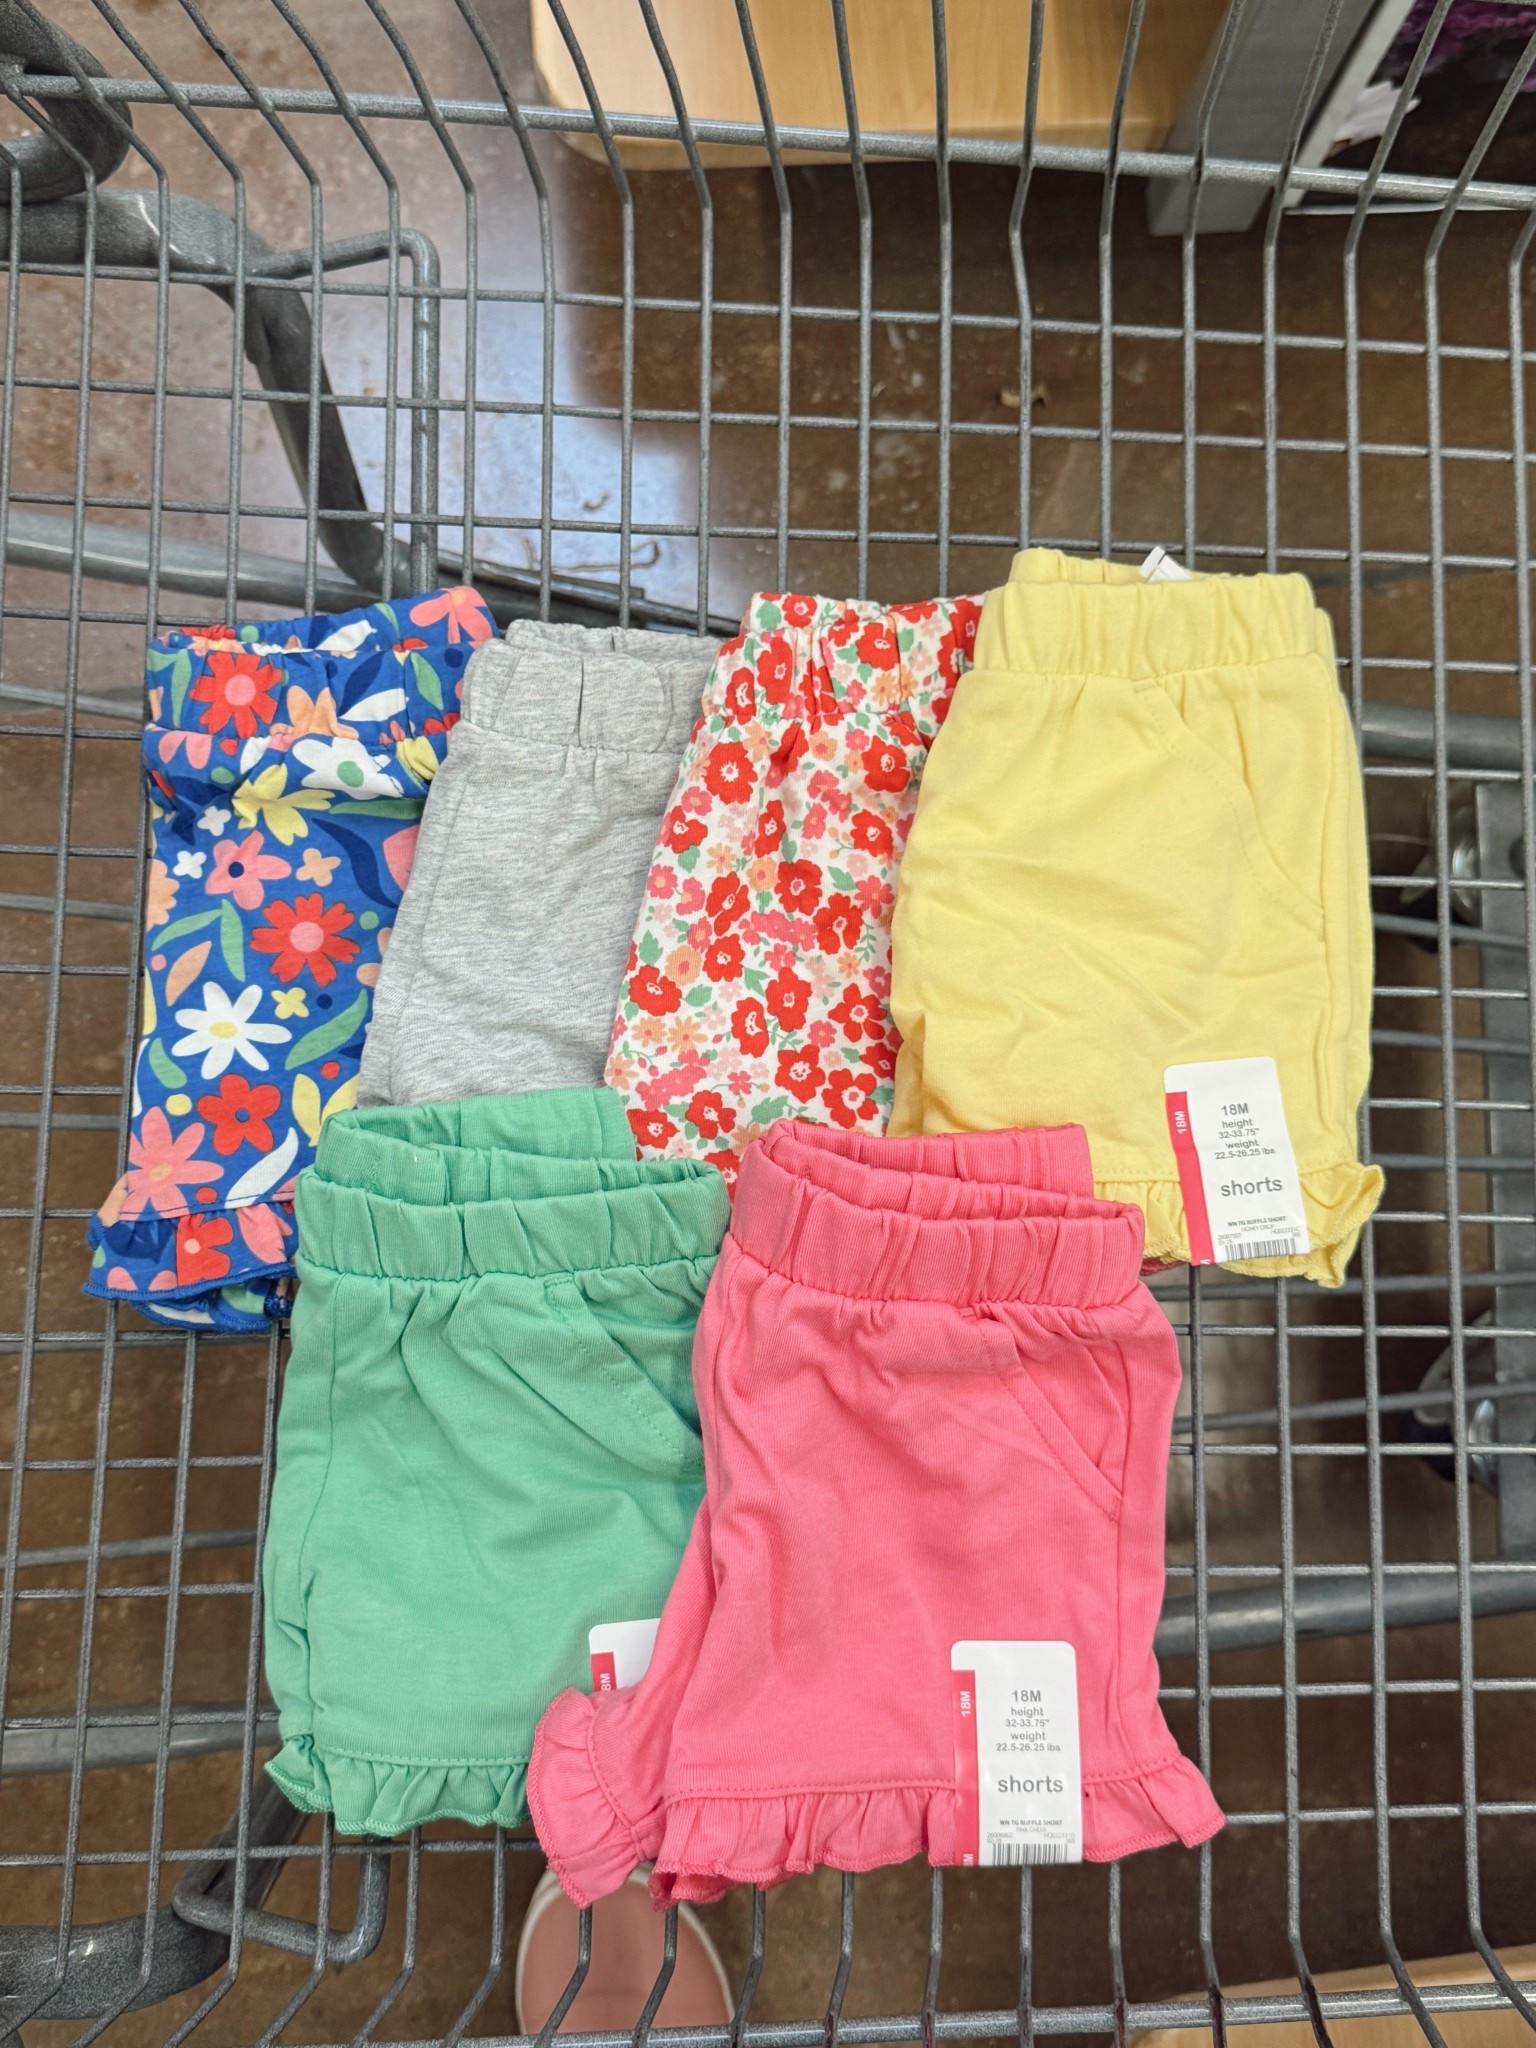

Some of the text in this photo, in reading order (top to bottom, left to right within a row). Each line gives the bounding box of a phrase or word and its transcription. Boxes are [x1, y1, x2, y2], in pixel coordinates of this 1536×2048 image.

[1221, 1102, 1249, 1116] 18M
[1174, 1110, 1188, 1134] 18M
[1222, 1118, 1253, 1129] height
[1218, 1128, 1260, 1139] 32-33.75"
[1225, 1138, 1259, 1150] weight
[1214, 1149, 1260, 1160] 22.5-26.25
[1220, 1177, 1283, 1197] shorts
[600, 1673, 612, 1691] 8M
[1012, 1689, 1042, 1703] 18M
[960, 1690, 971, 1716] 18M
[1010, 1706, 1044, 1717] height
[1005, 1718, 1050, 1728] 32-33.75"
[1010, 1730, 1047, 1742] weight
[996, 1743, 1061, 1752] 22.5-26.25 lbs
[997, 1774, 1064, 1793] shorts
